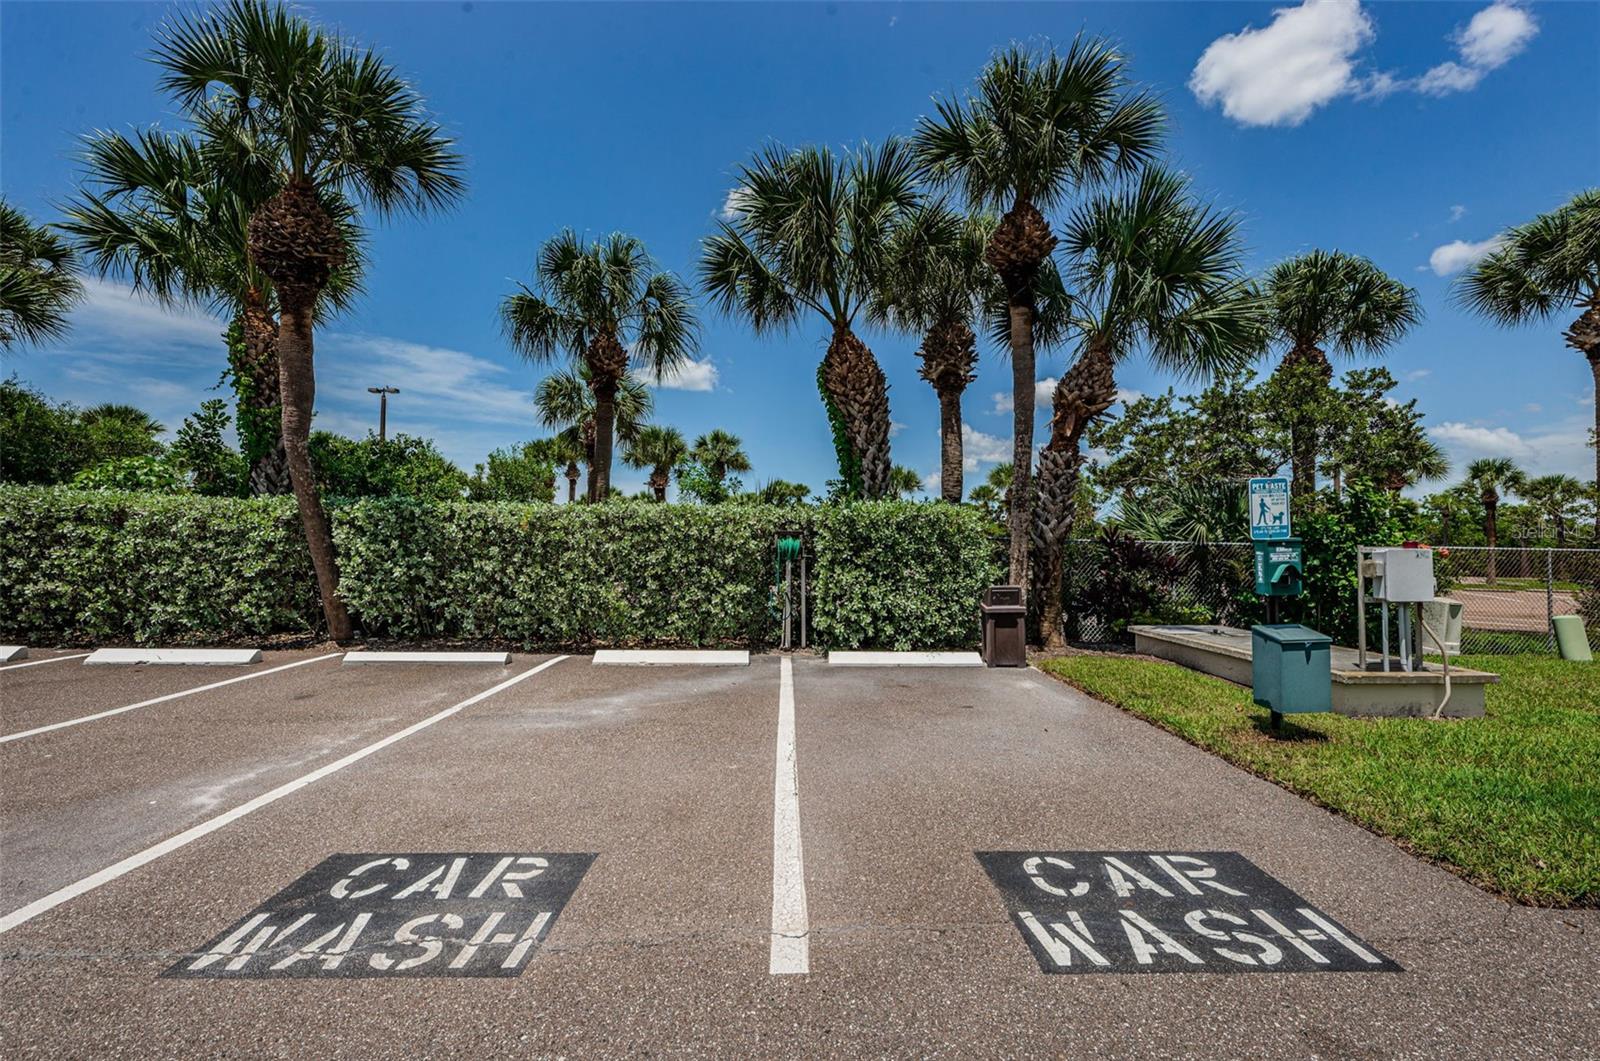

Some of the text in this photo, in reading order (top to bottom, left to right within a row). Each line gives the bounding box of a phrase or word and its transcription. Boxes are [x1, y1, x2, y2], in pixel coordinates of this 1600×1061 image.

[330, 857, 549, 899] CAR
[1022, 855, 1247, 897] CAR
[187, 912, 551, 970] WASH
[1018, 908, 1382, 967] WASH
